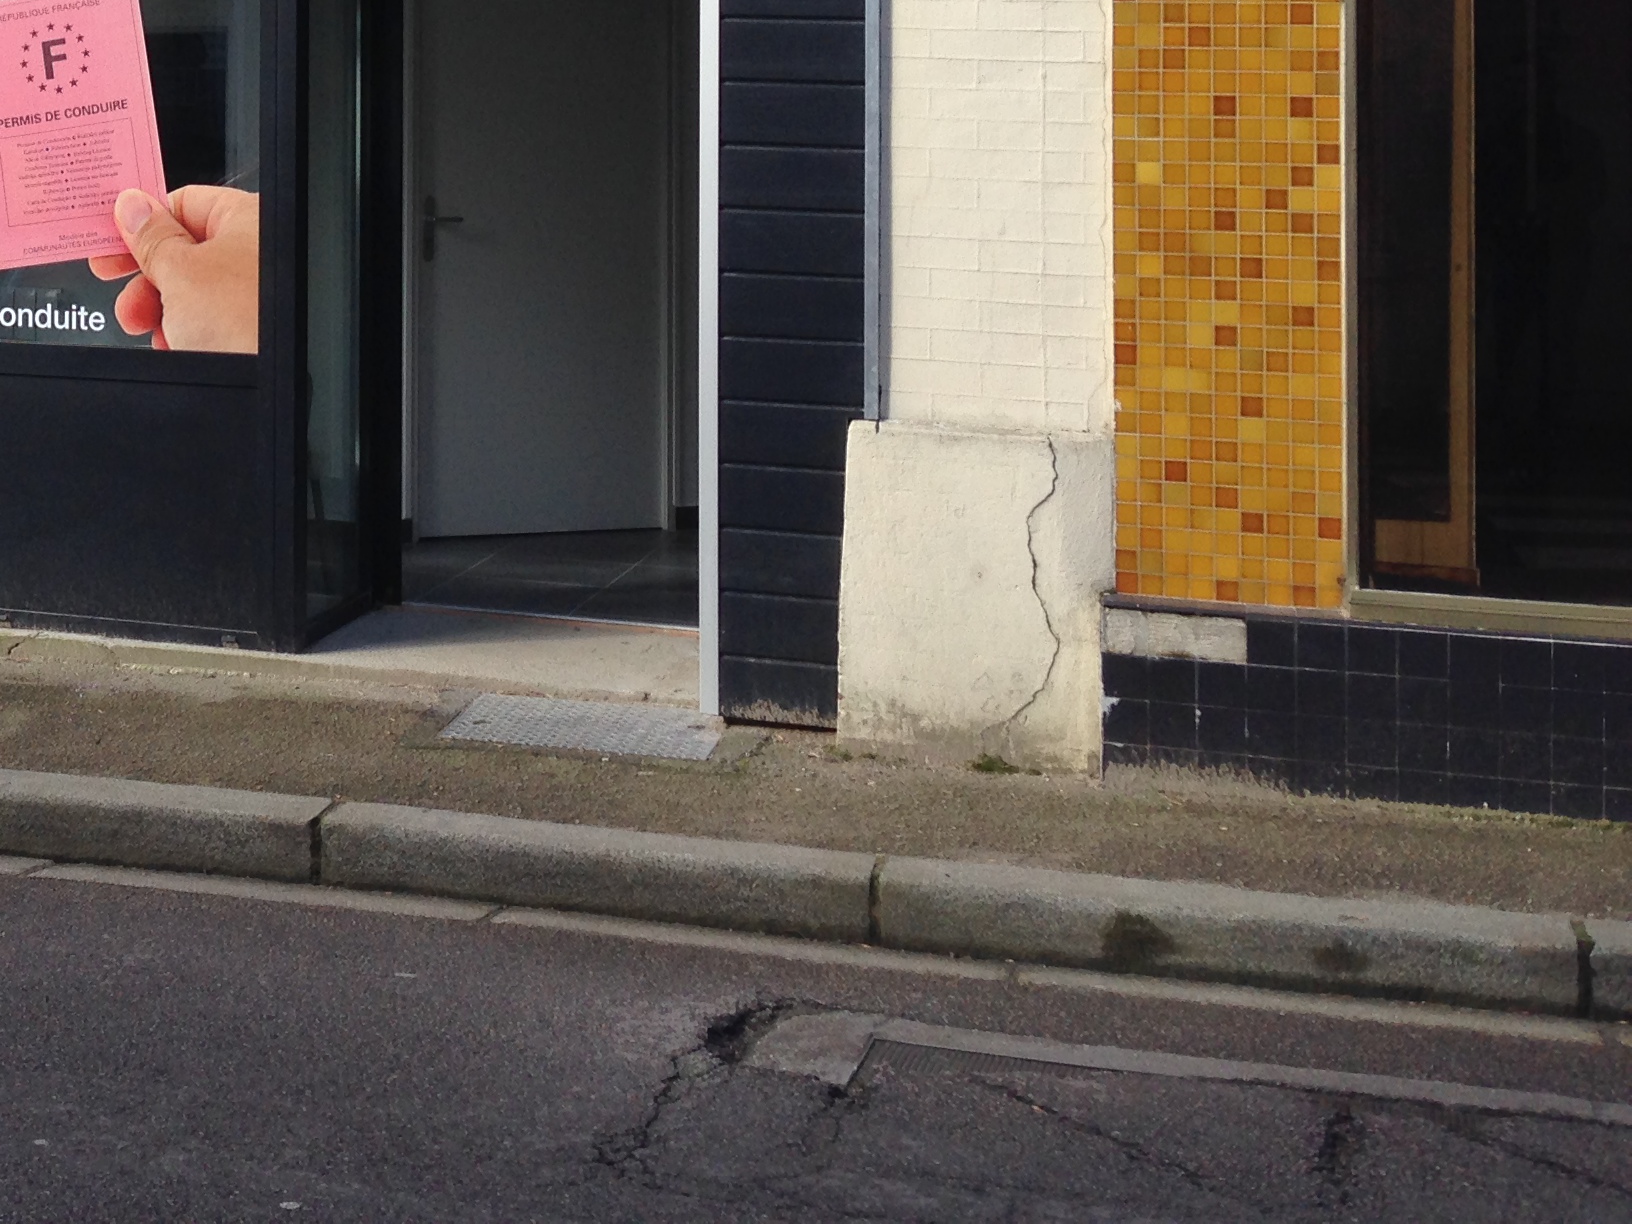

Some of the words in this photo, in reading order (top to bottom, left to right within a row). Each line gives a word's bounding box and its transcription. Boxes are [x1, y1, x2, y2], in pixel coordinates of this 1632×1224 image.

[41, 37, 67, 80] F
[45, 110, 61, 123] DE
[64, 98, 129, 119] CONDUIRE
